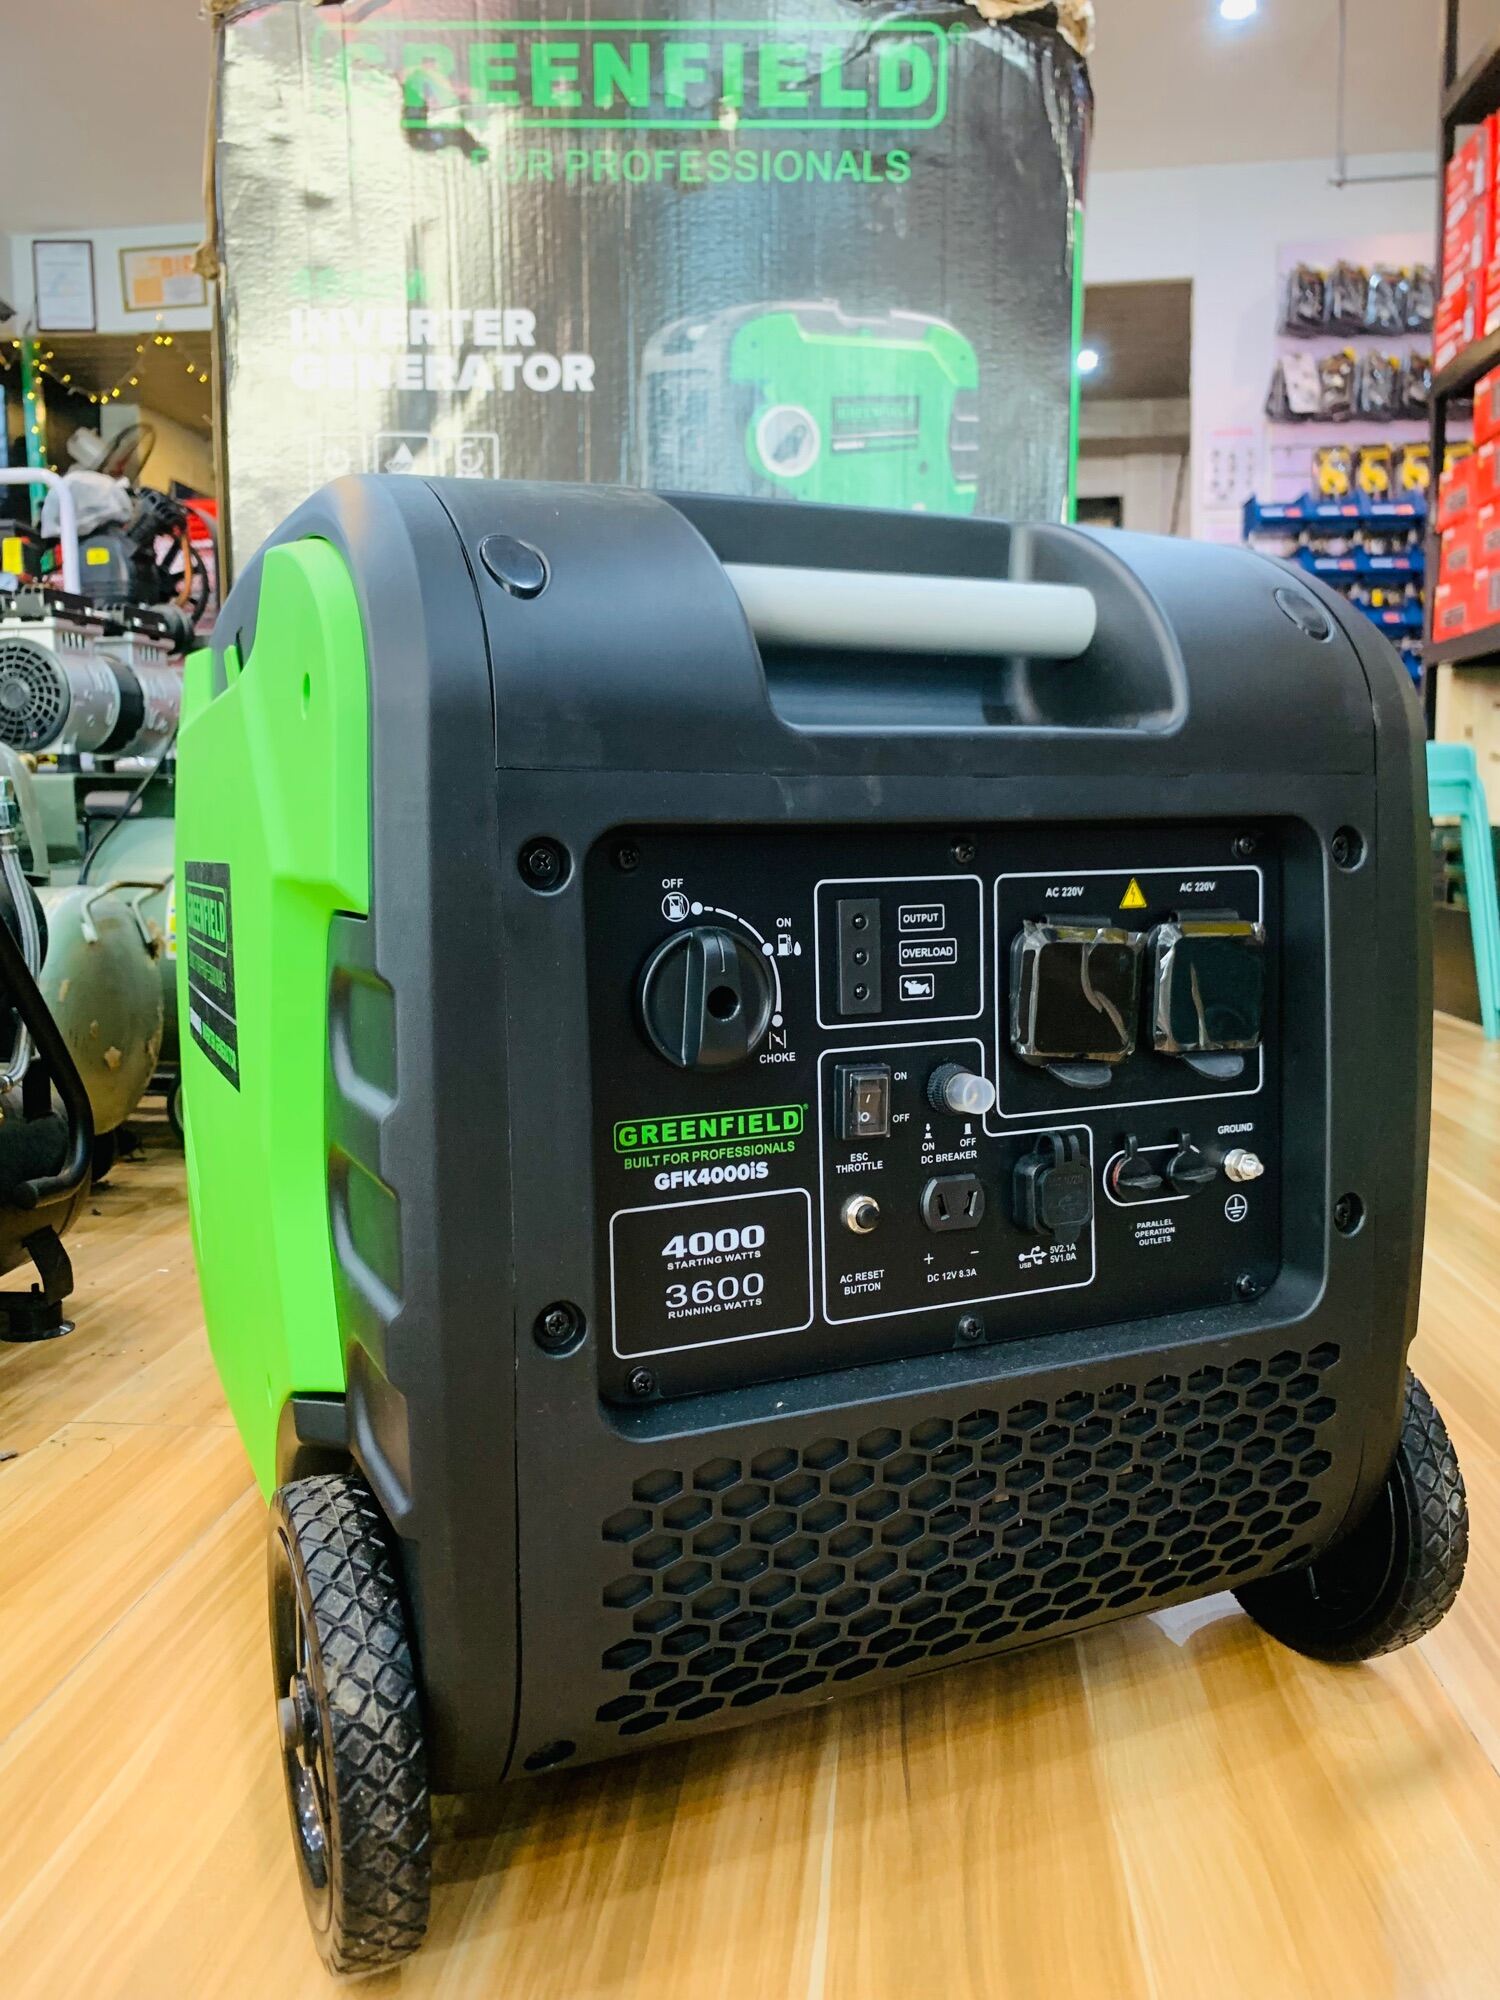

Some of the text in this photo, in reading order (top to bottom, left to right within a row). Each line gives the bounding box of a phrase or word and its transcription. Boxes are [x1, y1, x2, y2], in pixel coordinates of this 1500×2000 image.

[565, 148, 912, 184] PROFESSIONALS
[290, 308, 537, 347] INVERTER
[291, 353, 596, 393] GENERATOR
[662, 879, 683, 888] OFF
[1179, 881, 1216, 893] AC 220V
[1045, 886, 1084, 898] AC 220V
[776, 918, 792, 928] ON
[902, 912, 939, 924] OUTPUT
[901, 946, 954, 959] OVERLOAD
[759, 1052, 796, 1064] CHOKE
[894, 1072, 907, 1081] ON
[892, 1113, 911, 1123] OFF
[618, 1110, 800, 1147] GREENFIELD
[1217, 1122, 1254, 1135] GROUND
[921, 1141, 935, 1152] ON
[959, 1138, 977, 1147] OFF
[624, 1141, 795, 1170] BUILT FOR PROFESSIONALS
[850, 1152, 869, 1163] ESC
[920, 1150, 978, 1165] DC BREAKER
[836, 1160, 884, 1174] THROTTLE
[654, 1161, 769, 1191] GFK4000iS
[1136, 1218, 1174, 1230] PARALLEL
[1134, 1226, 1176, 1239] OPERATION
[661, 1224, 766, 1259] 4000
[1138, 1235, 1172, 1247] OUTLETS
[667, 1250, 762, 1271] STARTING WATTS
[1019, 1261, 1032, 1269] USB
[839, 1269, 885, 1284] AC RESET
[927, 1267, 978, 1283] DC 12V 8.3A
[665, 1272, 765, 1309] 3600
[843, 1282, 882, 1296] BUTTON
[668, 1297, 763, 1319] RUNNING WATTS
